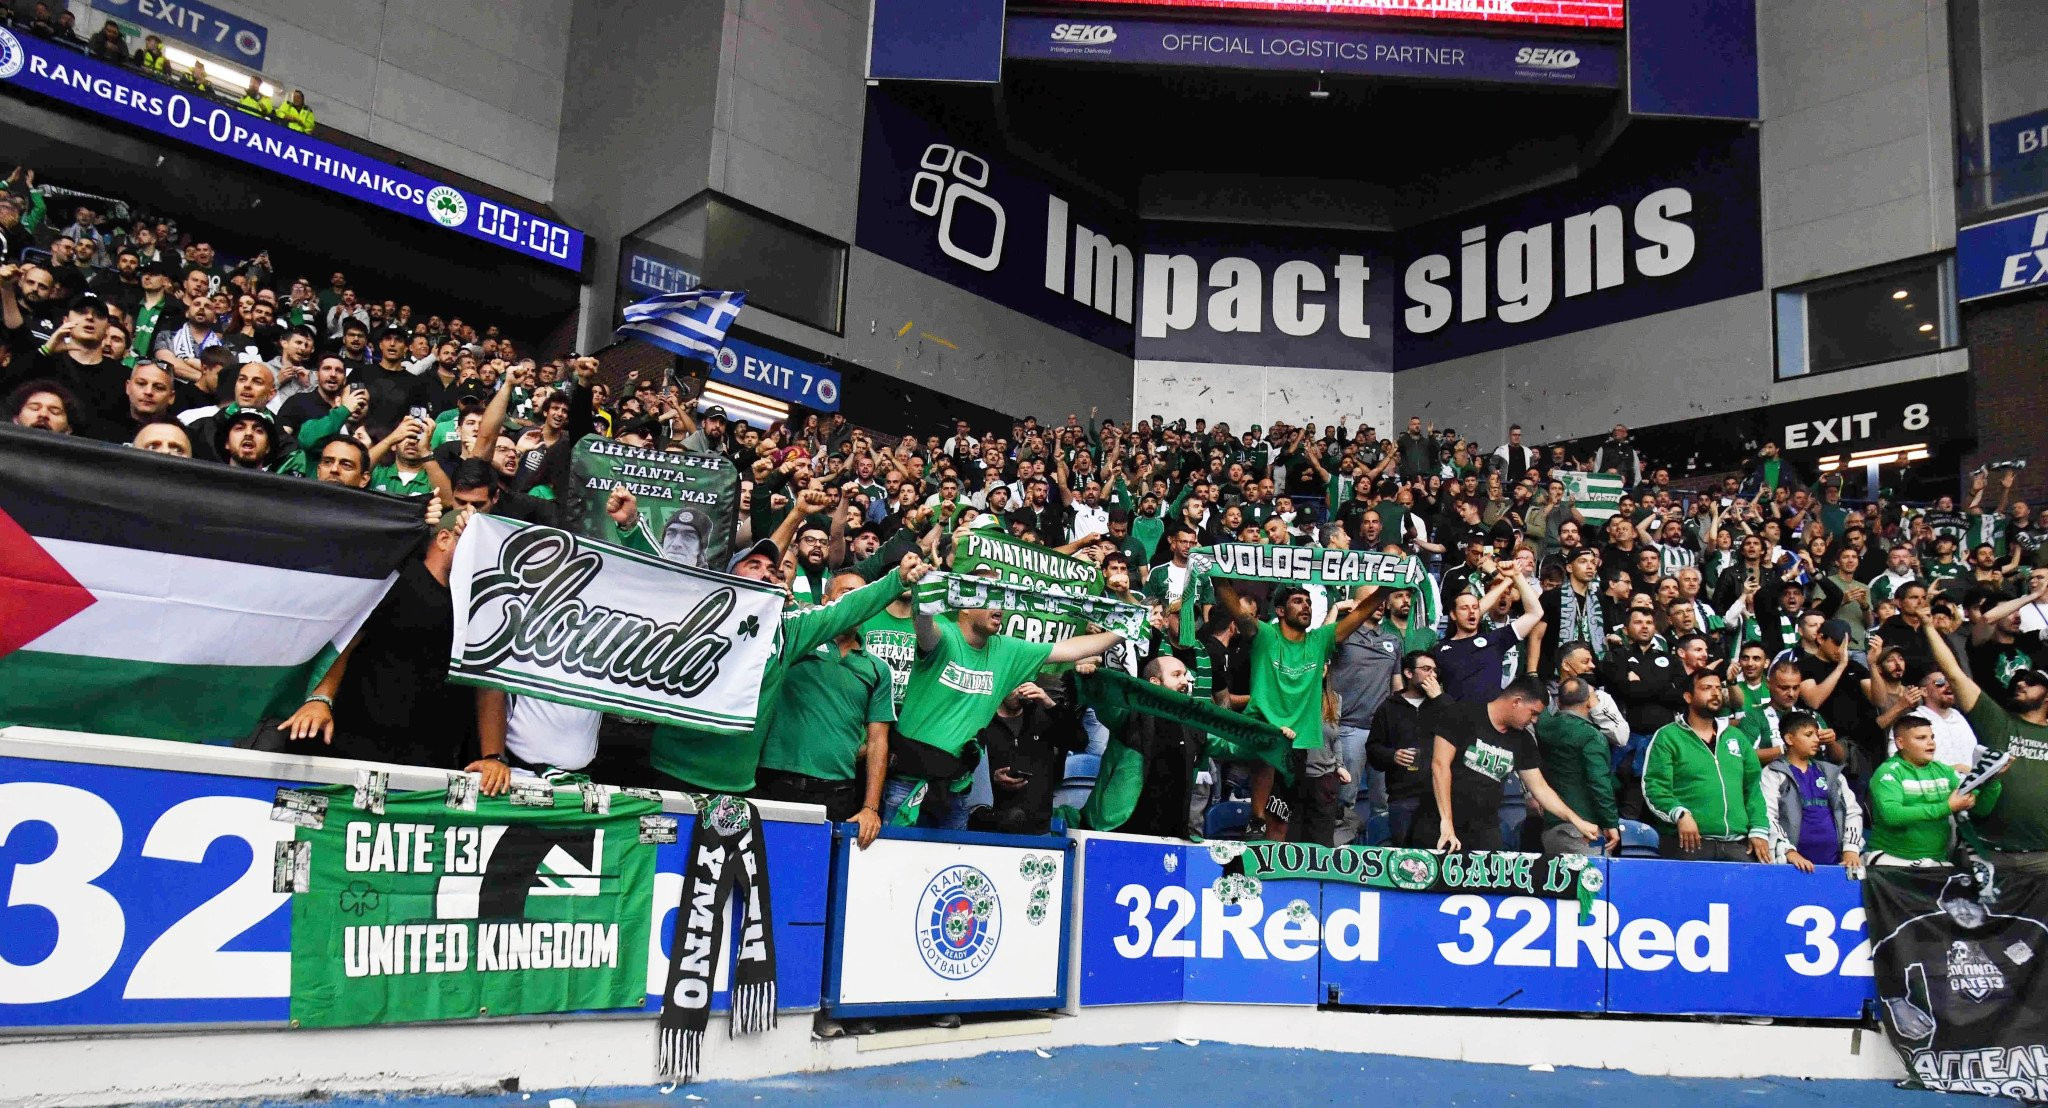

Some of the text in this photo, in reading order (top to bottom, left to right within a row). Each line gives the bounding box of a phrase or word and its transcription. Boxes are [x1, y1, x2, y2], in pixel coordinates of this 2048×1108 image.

[138, 0, 205, 34] EXIT
[214, 20, 230, 43] 7
[1050, 24, 1117, 44] SEKO
[1162, 34, 1465, 65] OFFICIAL LOGISTICS PARTNER
[1514, 47, 1581, 69] SEKO
[30, 54, 163, 116] RANGERS
[167, 94, 232, 142] 0-0
[233, 126, 424, 205] PANATHINAIKOS
[477, 201, 570, 259] 00:00
[1045, 186, 1696, 338] Impact signs
[743, 356, 813, 395] EXIT 7
[1785, 403, 1930, 450] EXIT 8
[589, 440, 722, 471] ΔΗΜΗΤΡΗ
[586, 477, 718, 505] ΑΝΑΜΕΣΑ ΜΑΣ
[1213, 544, 1313, 581] VOLOS
[1322, 551, 1400, 582] GATE
[462, 524, 738, 699] Elounda
[1006, 614, 1077, 643] CREW
[345, 821, 435, 873] GATE
[444, 826, 478, 874] 13
[1247, 843, 1572, 894] VOLOS GATE 13
[1112, 883, 1380, 961] 32Red
[1437, 893, 1729, 973] 32Red
[344, 923, 468, 978] UNITED
[476, 922, 619, 972] KINGDOM
[920, 929, 995, 975] FOOTBALL CLUB
[944, 950, 968, 959] READY
